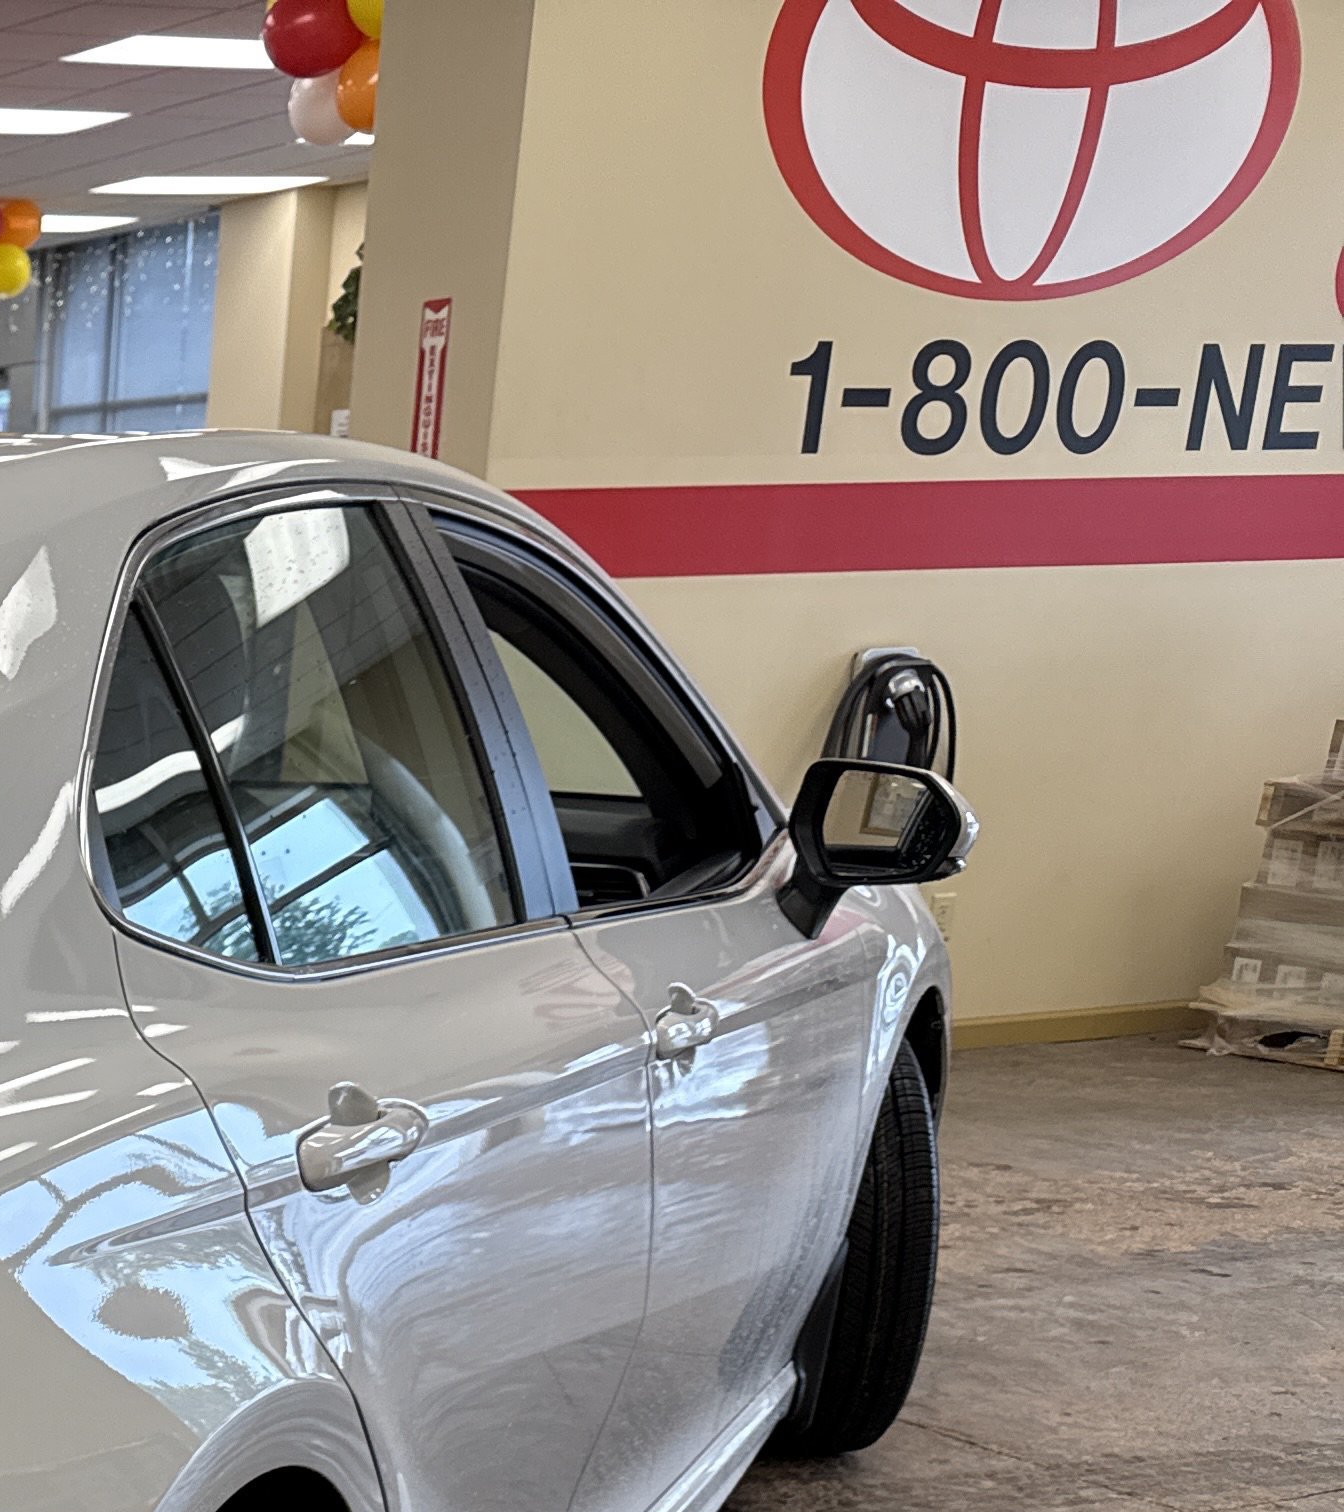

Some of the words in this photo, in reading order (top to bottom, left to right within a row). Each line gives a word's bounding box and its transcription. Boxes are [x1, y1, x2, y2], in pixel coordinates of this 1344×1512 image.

[423, 318, 446, 337] FIRE
[421, 344, 437, 458] EXTINGUIS
[789, 339, 1344, 456] 1-800-NE
